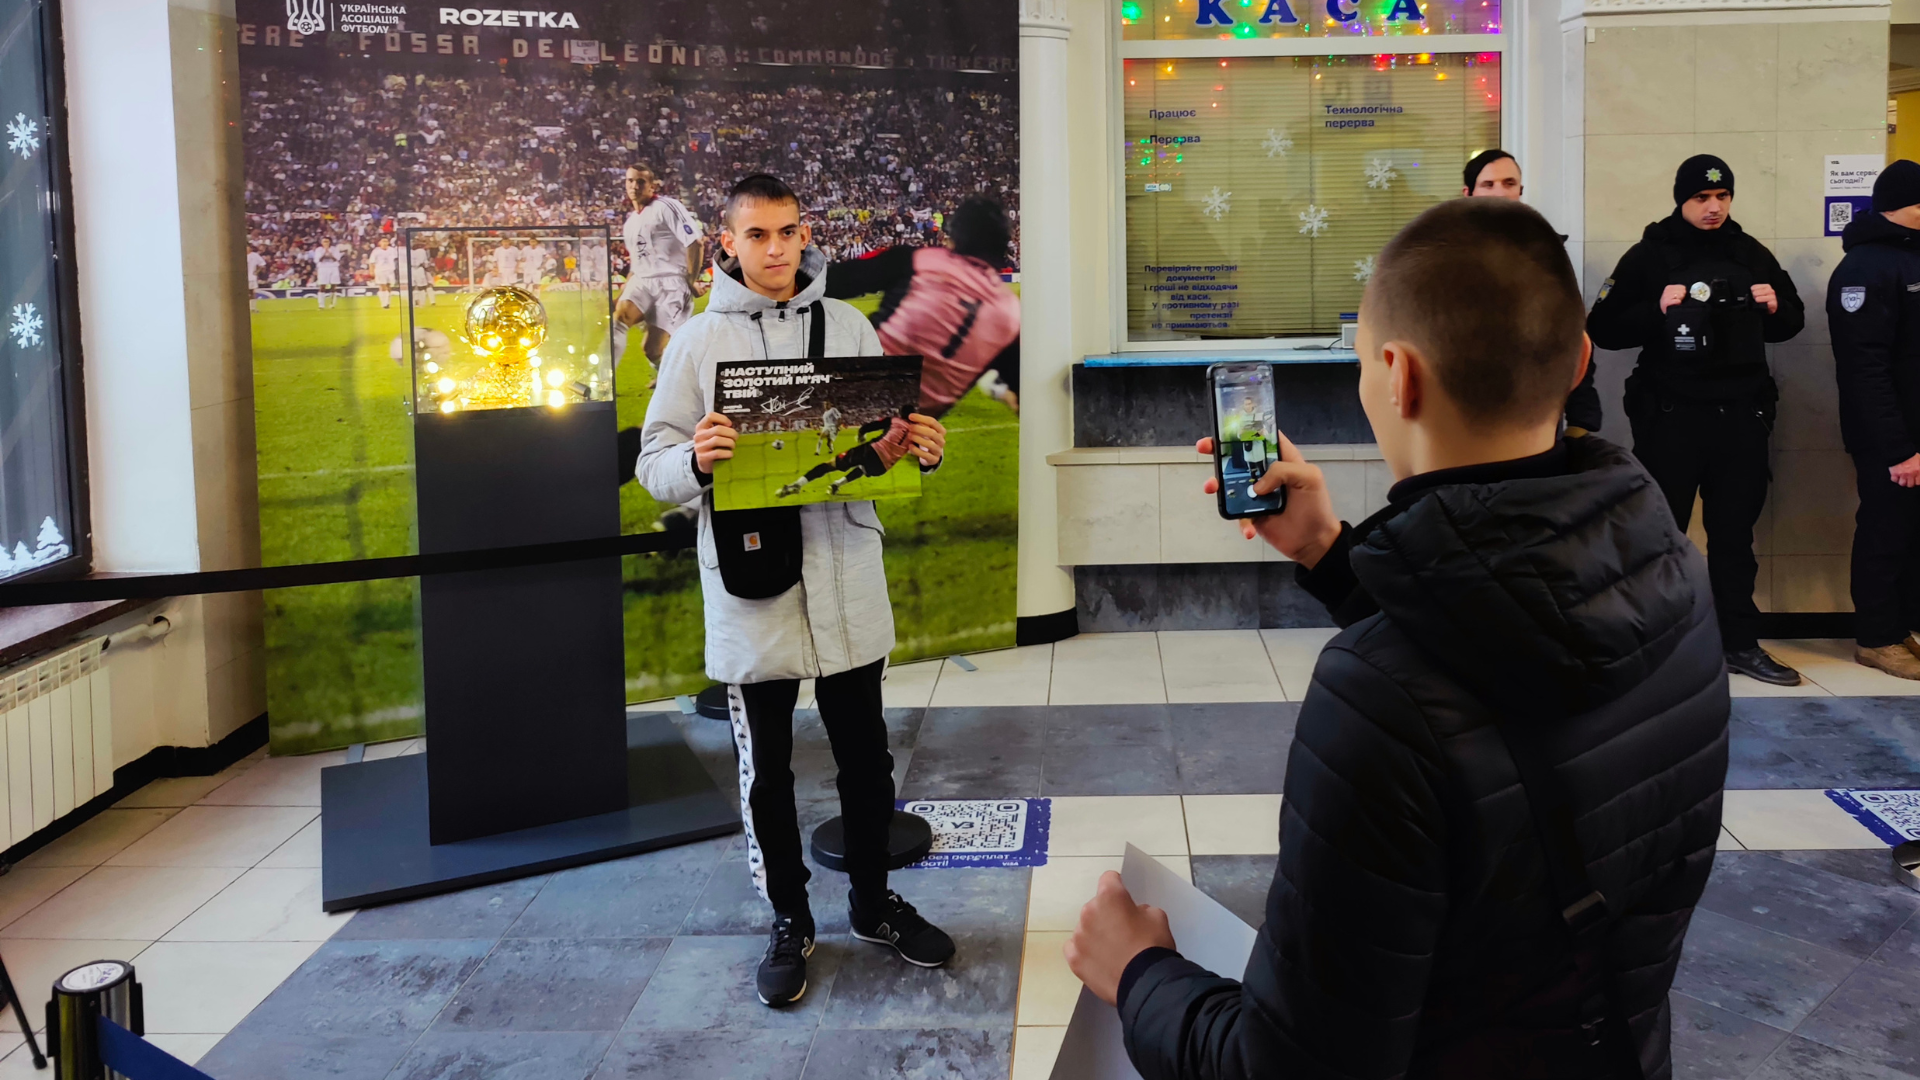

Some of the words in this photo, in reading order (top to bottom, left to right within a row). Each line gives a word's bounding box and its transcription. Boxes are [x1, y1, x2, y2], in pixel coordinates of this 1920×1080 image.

[340, 4, 407, 14] УКРАЇНСЬКА
[340, 14, 399, 24] АСОЦІАЦІЯ
[439, 8, 580, 29] ROZETKA
[341, 24, 389, 34] ФУТБОЛУ
[600, 42, 700, 67] LEONI
[1149, 109, 1196, 120] Працює
[1325, 104, 1403, 115] Технологічна
[1325, 119, 1375, 129] перерва
[1149, 135, 1201, 145] Перерва
[1144, 265, 1201, 273] Перевіряйте
[1204, 264, 1238, 272] проїзні
[1150, 284, 1176, 292] гроші
